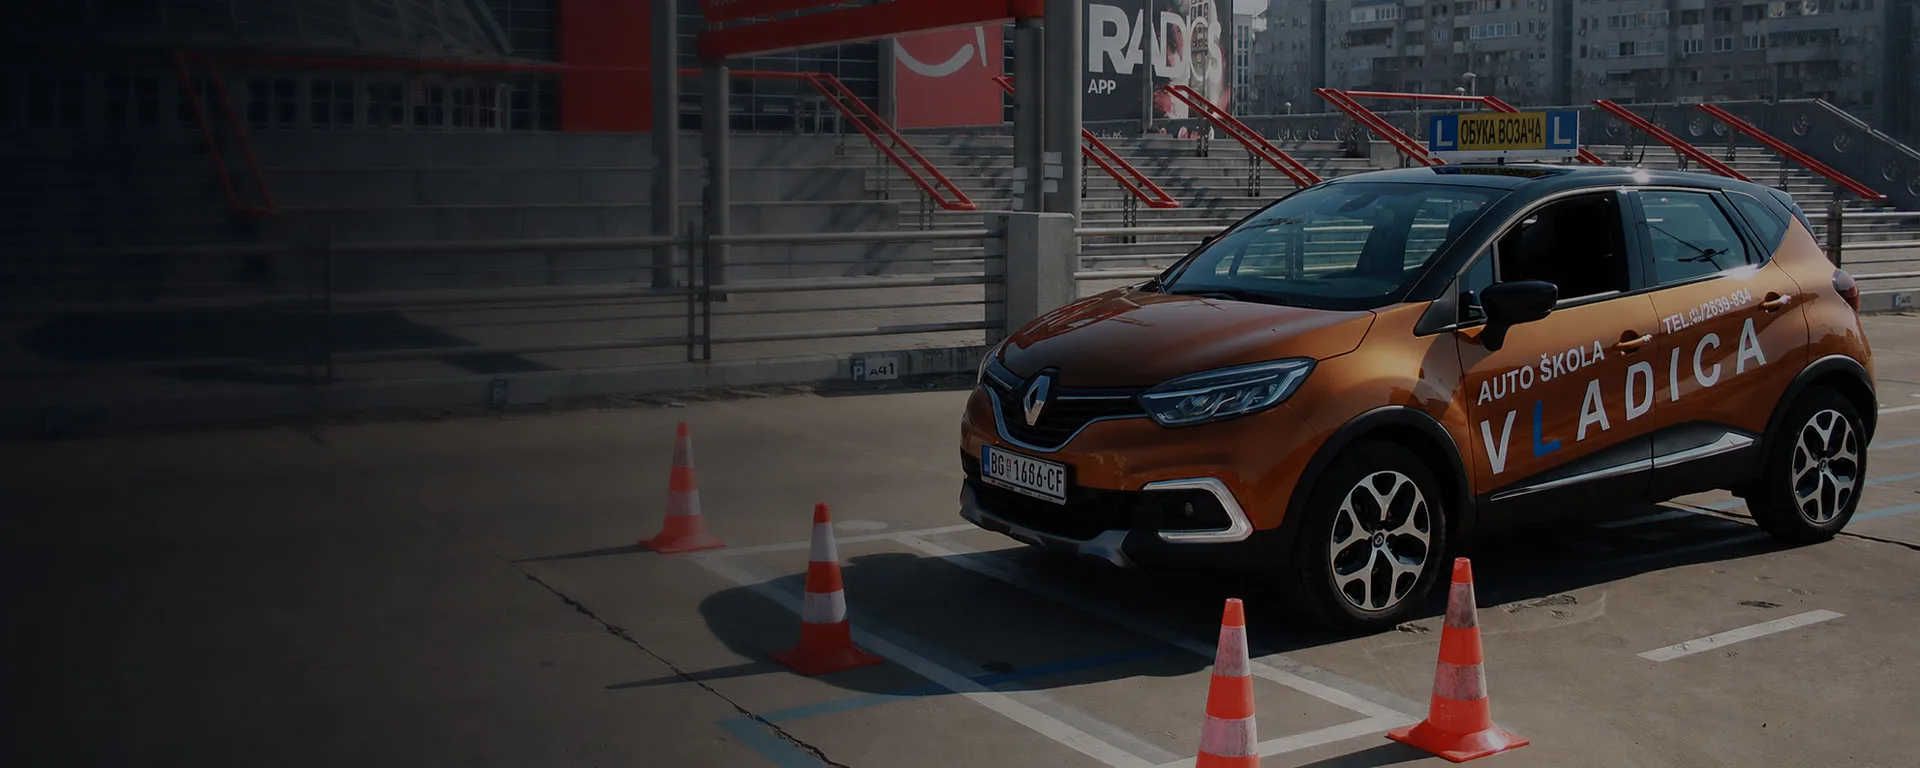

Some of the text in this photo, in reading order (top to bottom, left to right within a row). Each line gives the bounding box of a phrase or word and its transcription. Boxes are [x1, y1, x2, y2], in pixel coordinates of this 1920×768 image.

[1088, 78, 1116, 95] APP
[1436, 119, 1453, 147] L
[1460, 117, 1542, 146] ОБУКА ВОЗАЧА
[1553, 116, 1572, 145] L
[1477, 340, 1605, 406] AUTO ŠKOLA
[1480, 317, 1767, 476] VLADICA
[991, 452, 1004, 476] BG
